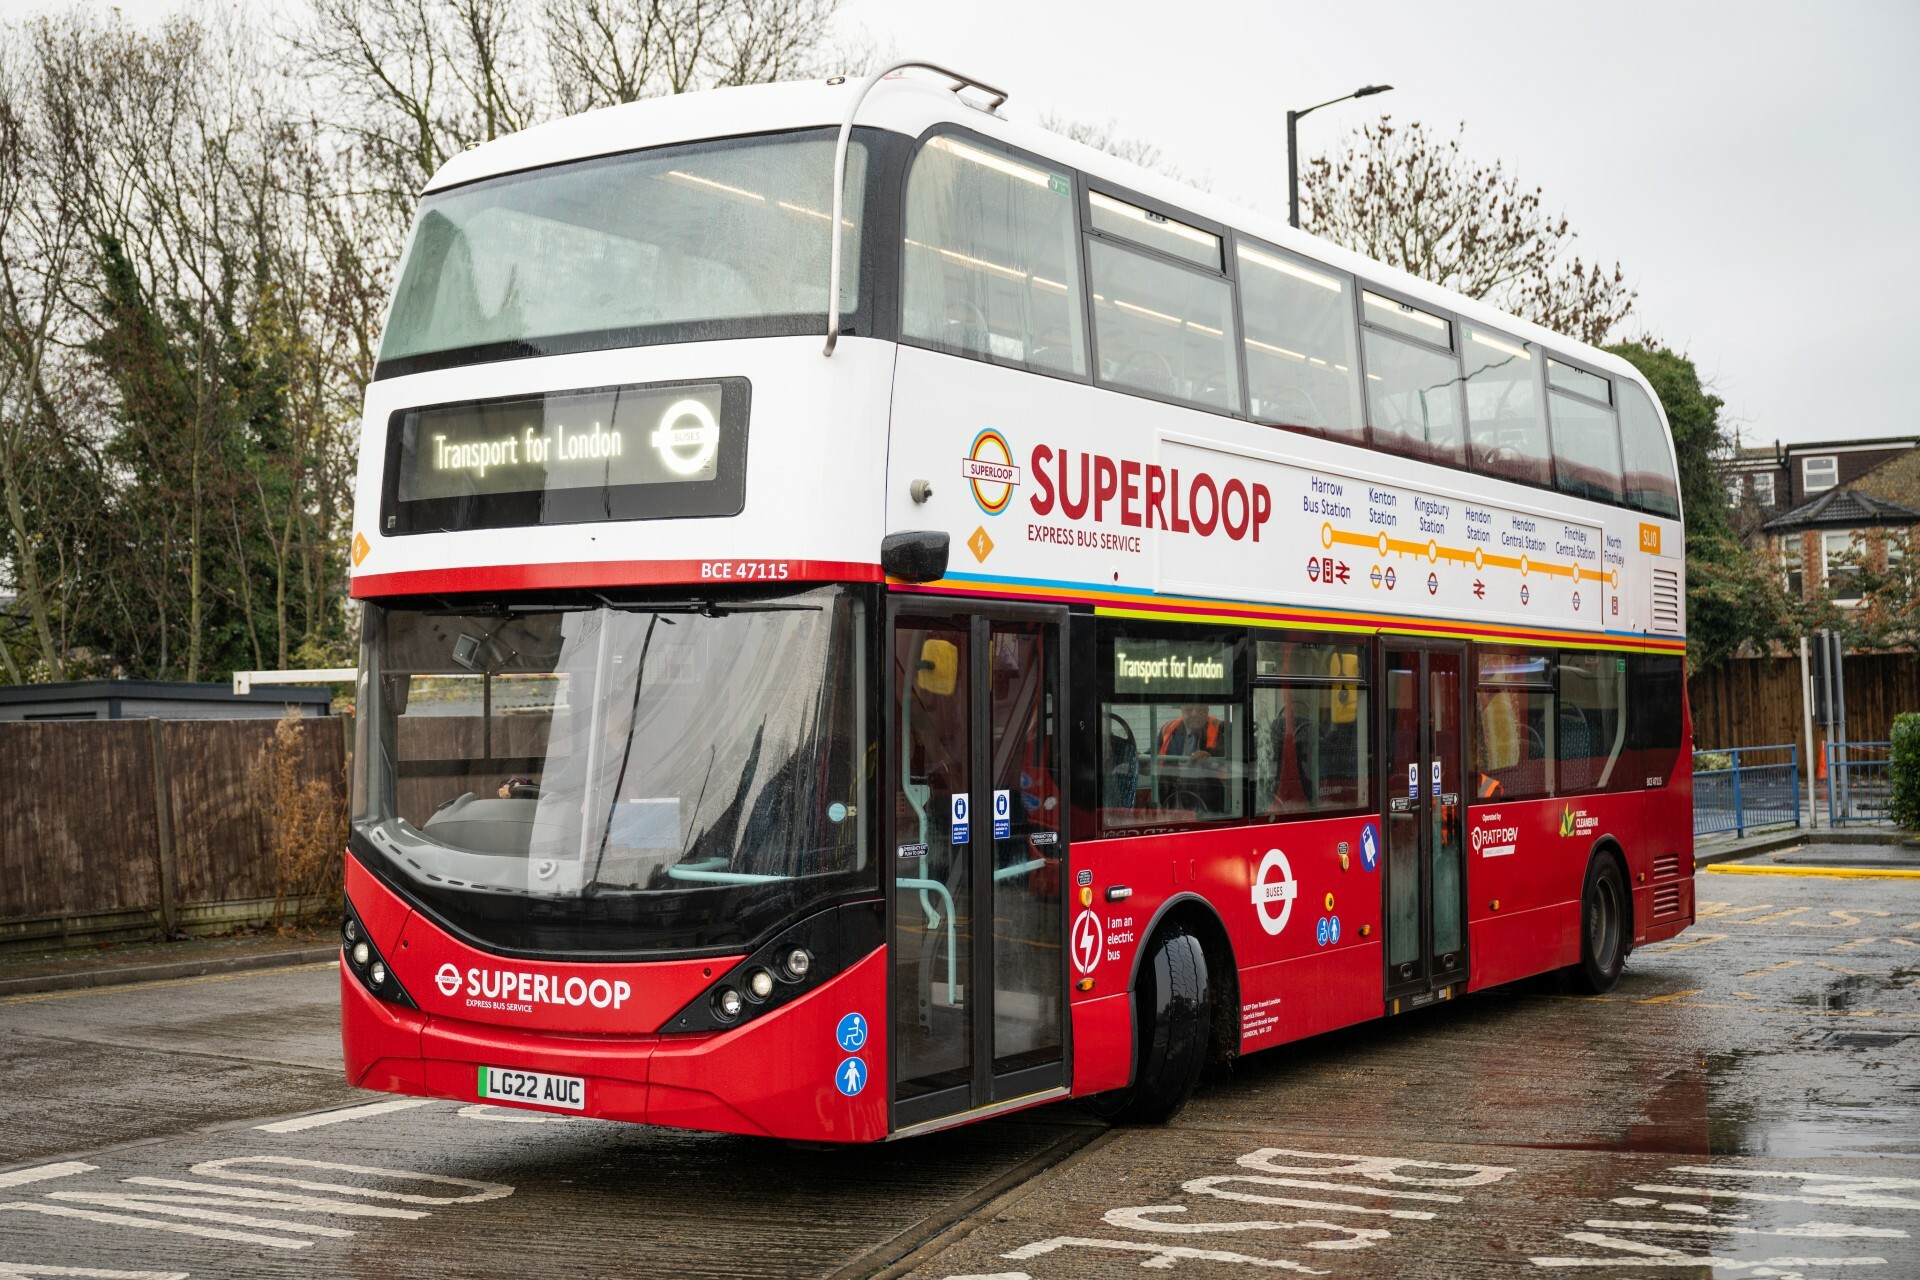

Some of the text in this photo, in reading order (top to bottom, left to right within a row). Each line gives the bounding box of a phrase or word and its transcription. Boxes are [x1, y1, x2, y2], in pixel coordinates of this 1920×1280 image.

[674, 431, 701, 442] BUSES
[435, 422, 622, 477] Transport for London
[970, 464, 1013, 480] SUPERLOOP
[1030, 444, 1272, 542] SUPERLOOP
[1311, 476, 1344, 496] Harrow
[1369, 487, 1397, 507] Kenton
[1303, 496, 1351, 518] Bus Station
[1414, 496, 1450, 520] Kingsbury
[1466, 506, 1492, 524] Hendon
[1369, 508, 1397, 526] Station
[1420, 516, 1444, 534] Station
[1512, 516, 1536, 533] Hendon
[1028, 524, 1141, 553] EXPRESS BUS SERVICE
[1466, 526, 1490, 542] Station
[1501, 532, 1546, 552] Central Station
[1564, 526, 1587, 545] Finchley
[1606, 534, 1622, 549] North
[1643, 529, 1657, 547] SL10
[1556, 542, 1596, 560] Central Station
[1604, 550, 1624, 568] Finchley
[702, 562, 788, 580] BCE 47115
[1116, 653, 1224, 684] Transport for London
[1482, 813, 1501, 822] Operated by
[1482, 828, 1501, 845] RATP
[1265, 885, 1284, 898] BUSES
[1107, 916, 1133, 929] I am an
[1107, 930, 1134, 945] electric
[1107, 949, 1121, 961] bus
[466, 968, 631, 1010] SUPERLOOP
[466, 998, 532, 1013] EXPRESS BUS SERVICE
[490, 1070, 580, 1104] LG22 AUC
